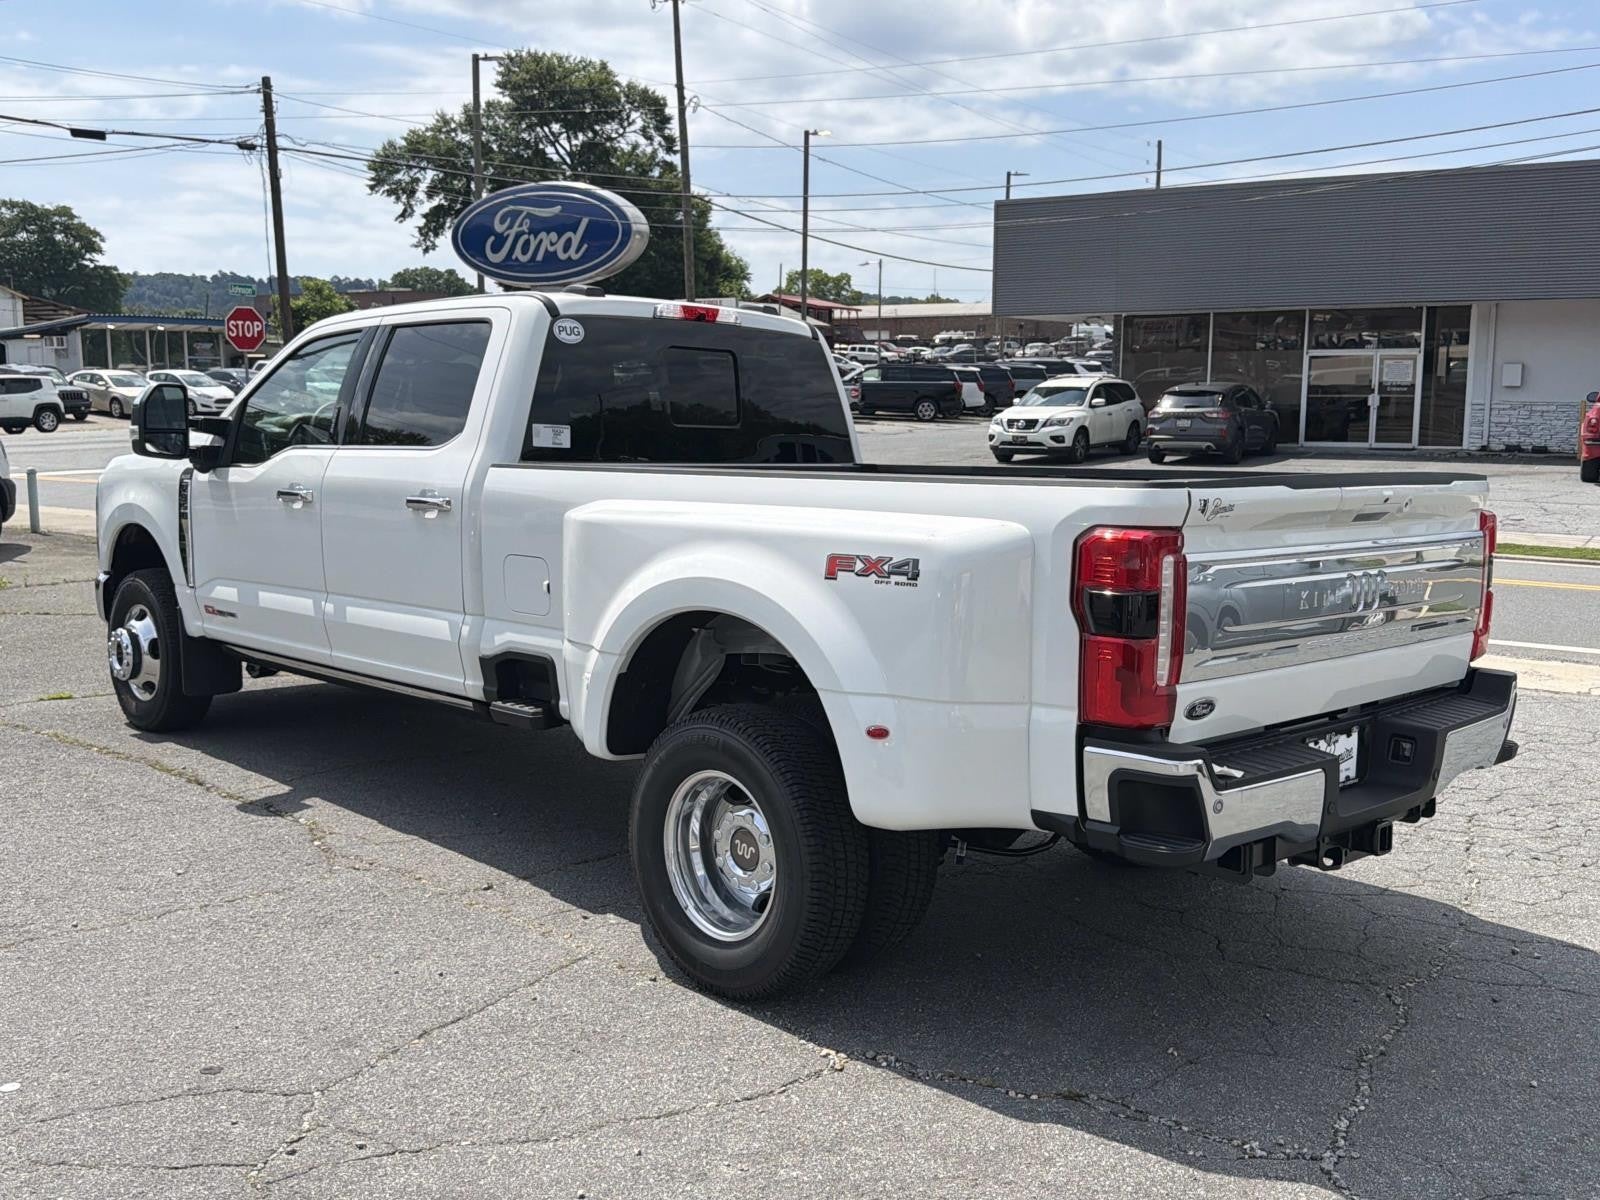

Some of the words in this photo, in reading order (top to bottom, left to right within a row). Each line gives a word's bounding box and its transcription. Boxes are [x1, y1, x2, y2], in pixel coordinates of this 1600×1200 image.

[485, 205, 589, 263] Ford
[228, 320, 262, 338] STOP
[558, 325, 580, 336] PUG
[824, 553, 920, 581] FX4
[1299, 587, 1342, 610] KING
